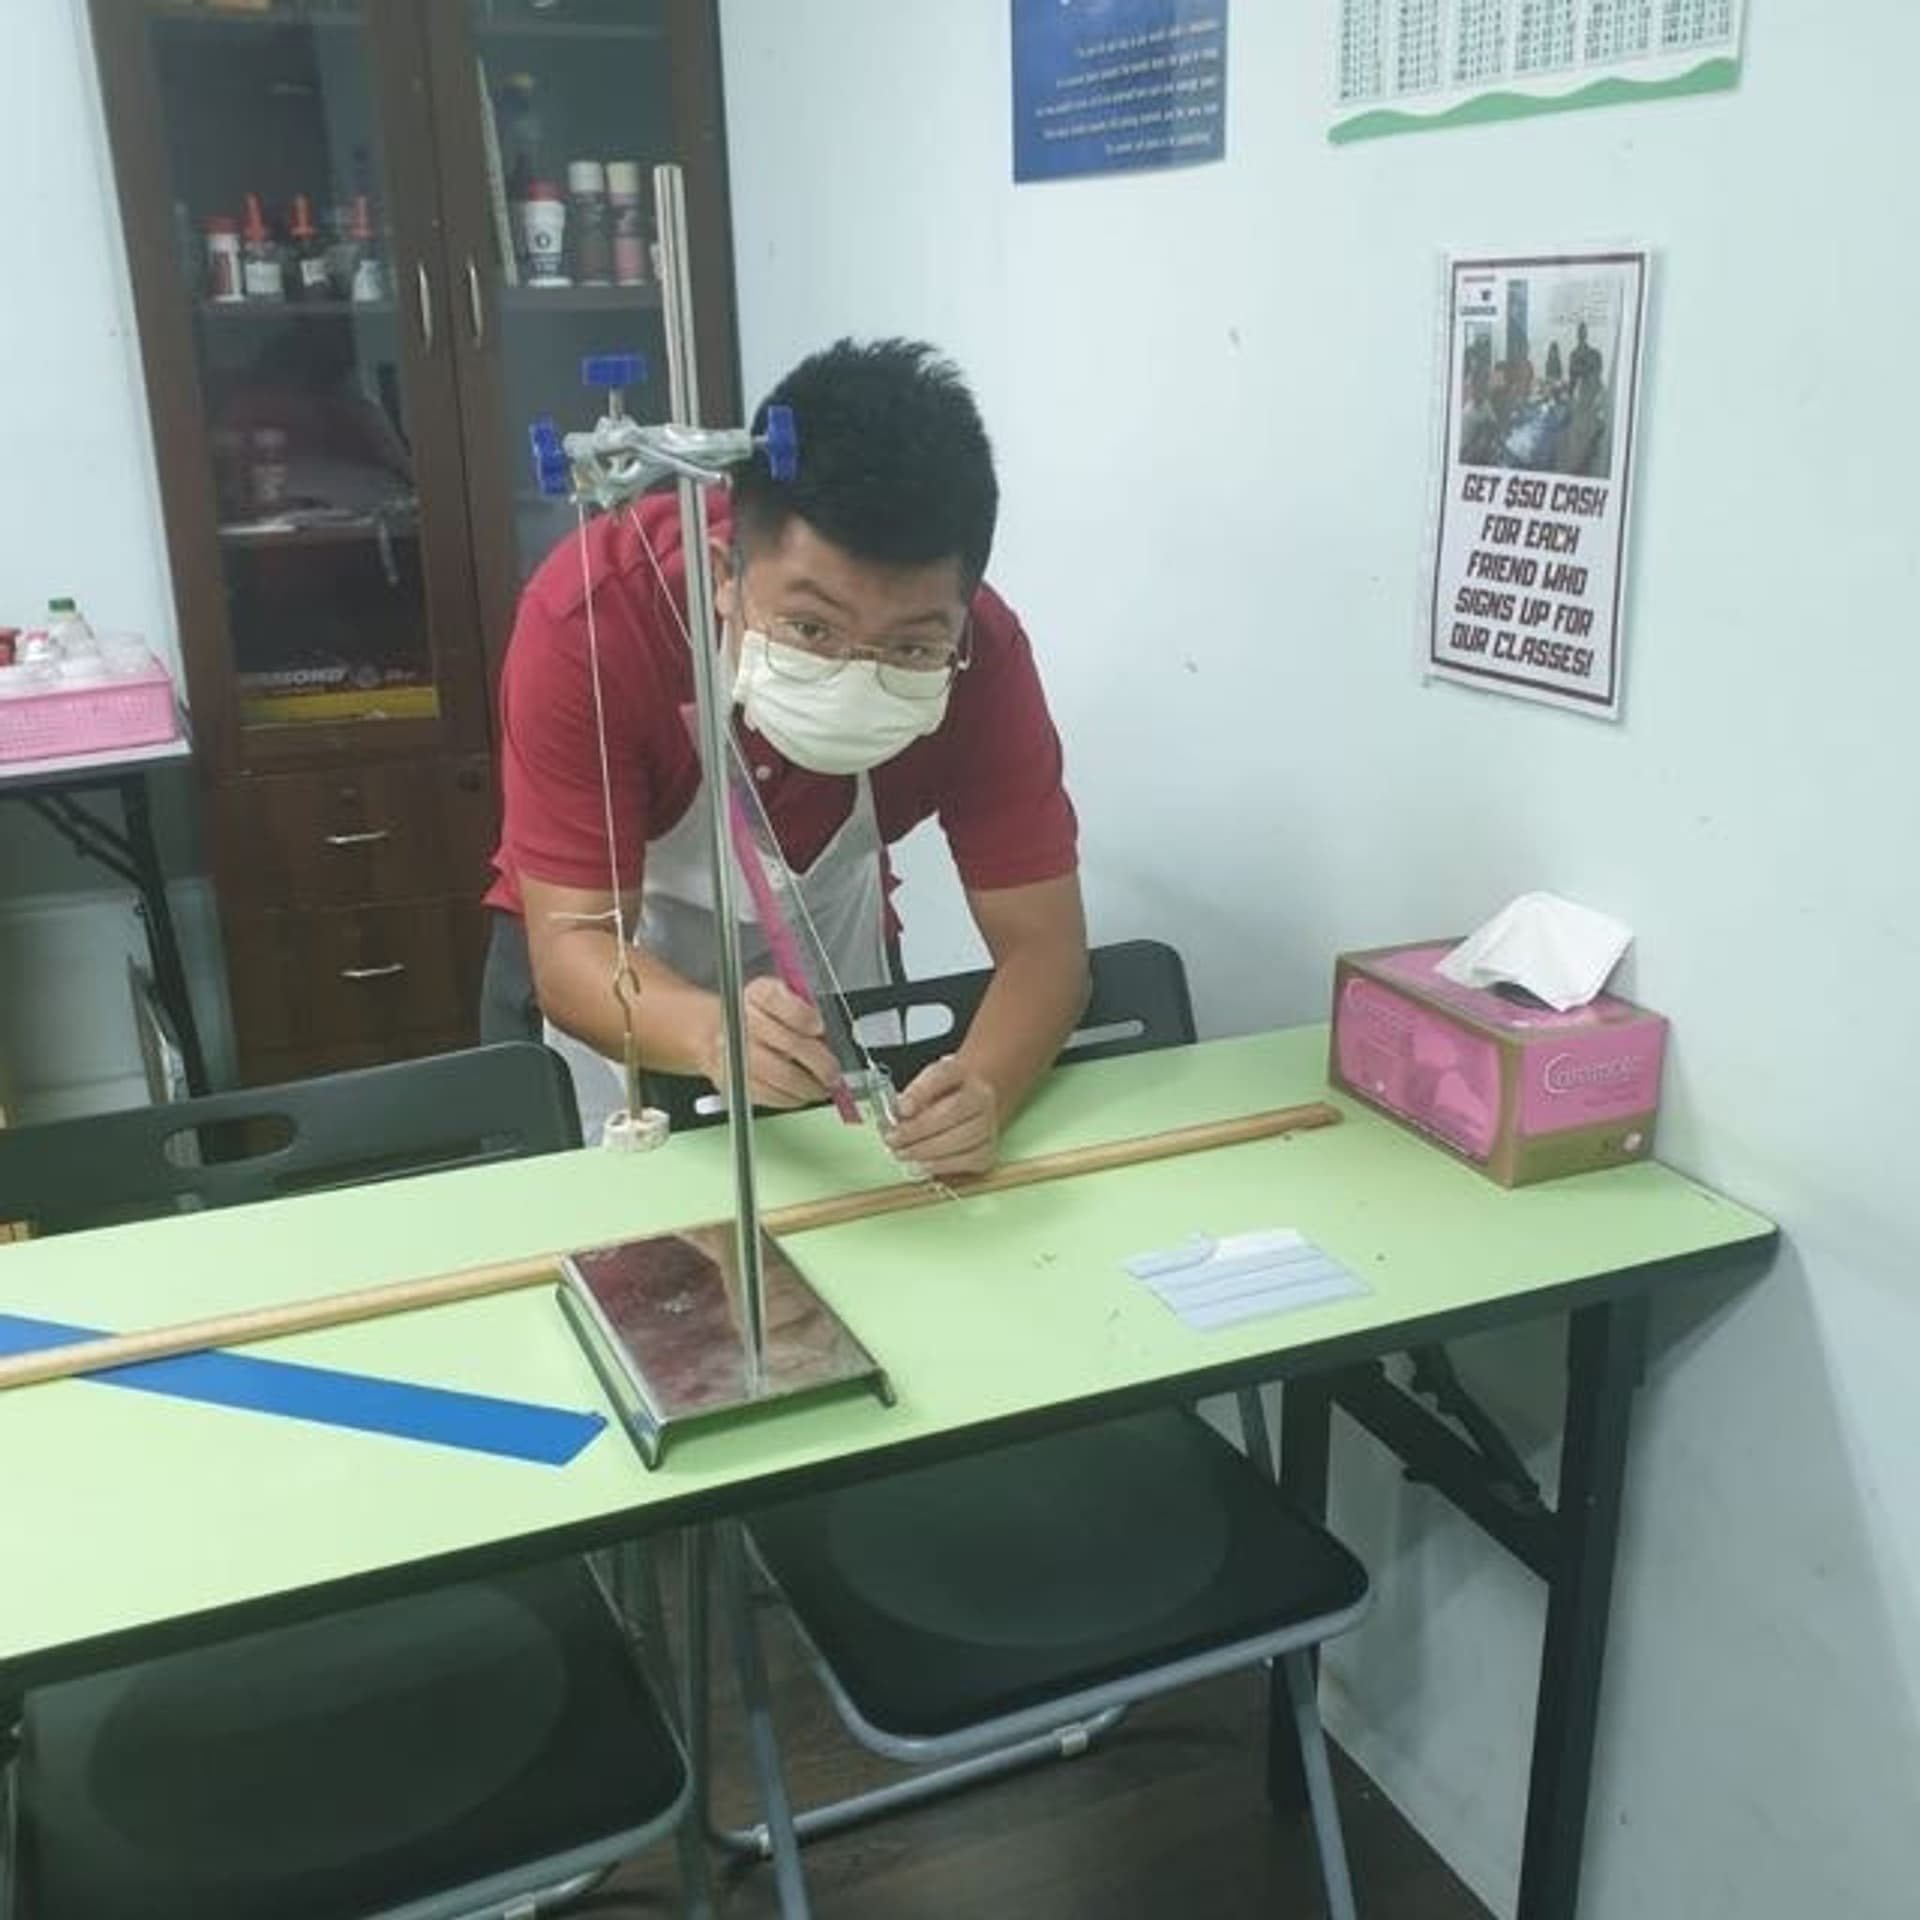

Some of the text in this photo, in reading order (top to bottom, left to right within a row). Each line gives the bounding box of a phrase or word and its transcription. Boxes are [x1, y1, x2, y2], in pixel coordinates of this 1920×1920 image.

[1461, 473, 1609, 519] GET $50 CASH
[1481, 514, 1581, 555] FOR EACH
[1467, 551, 1588, 596] FRIEND WHO
[1454, 587, 1594, 637] SIGNS UP FOR
[1450, 622, 1595, 678] OUR CLASSES!
